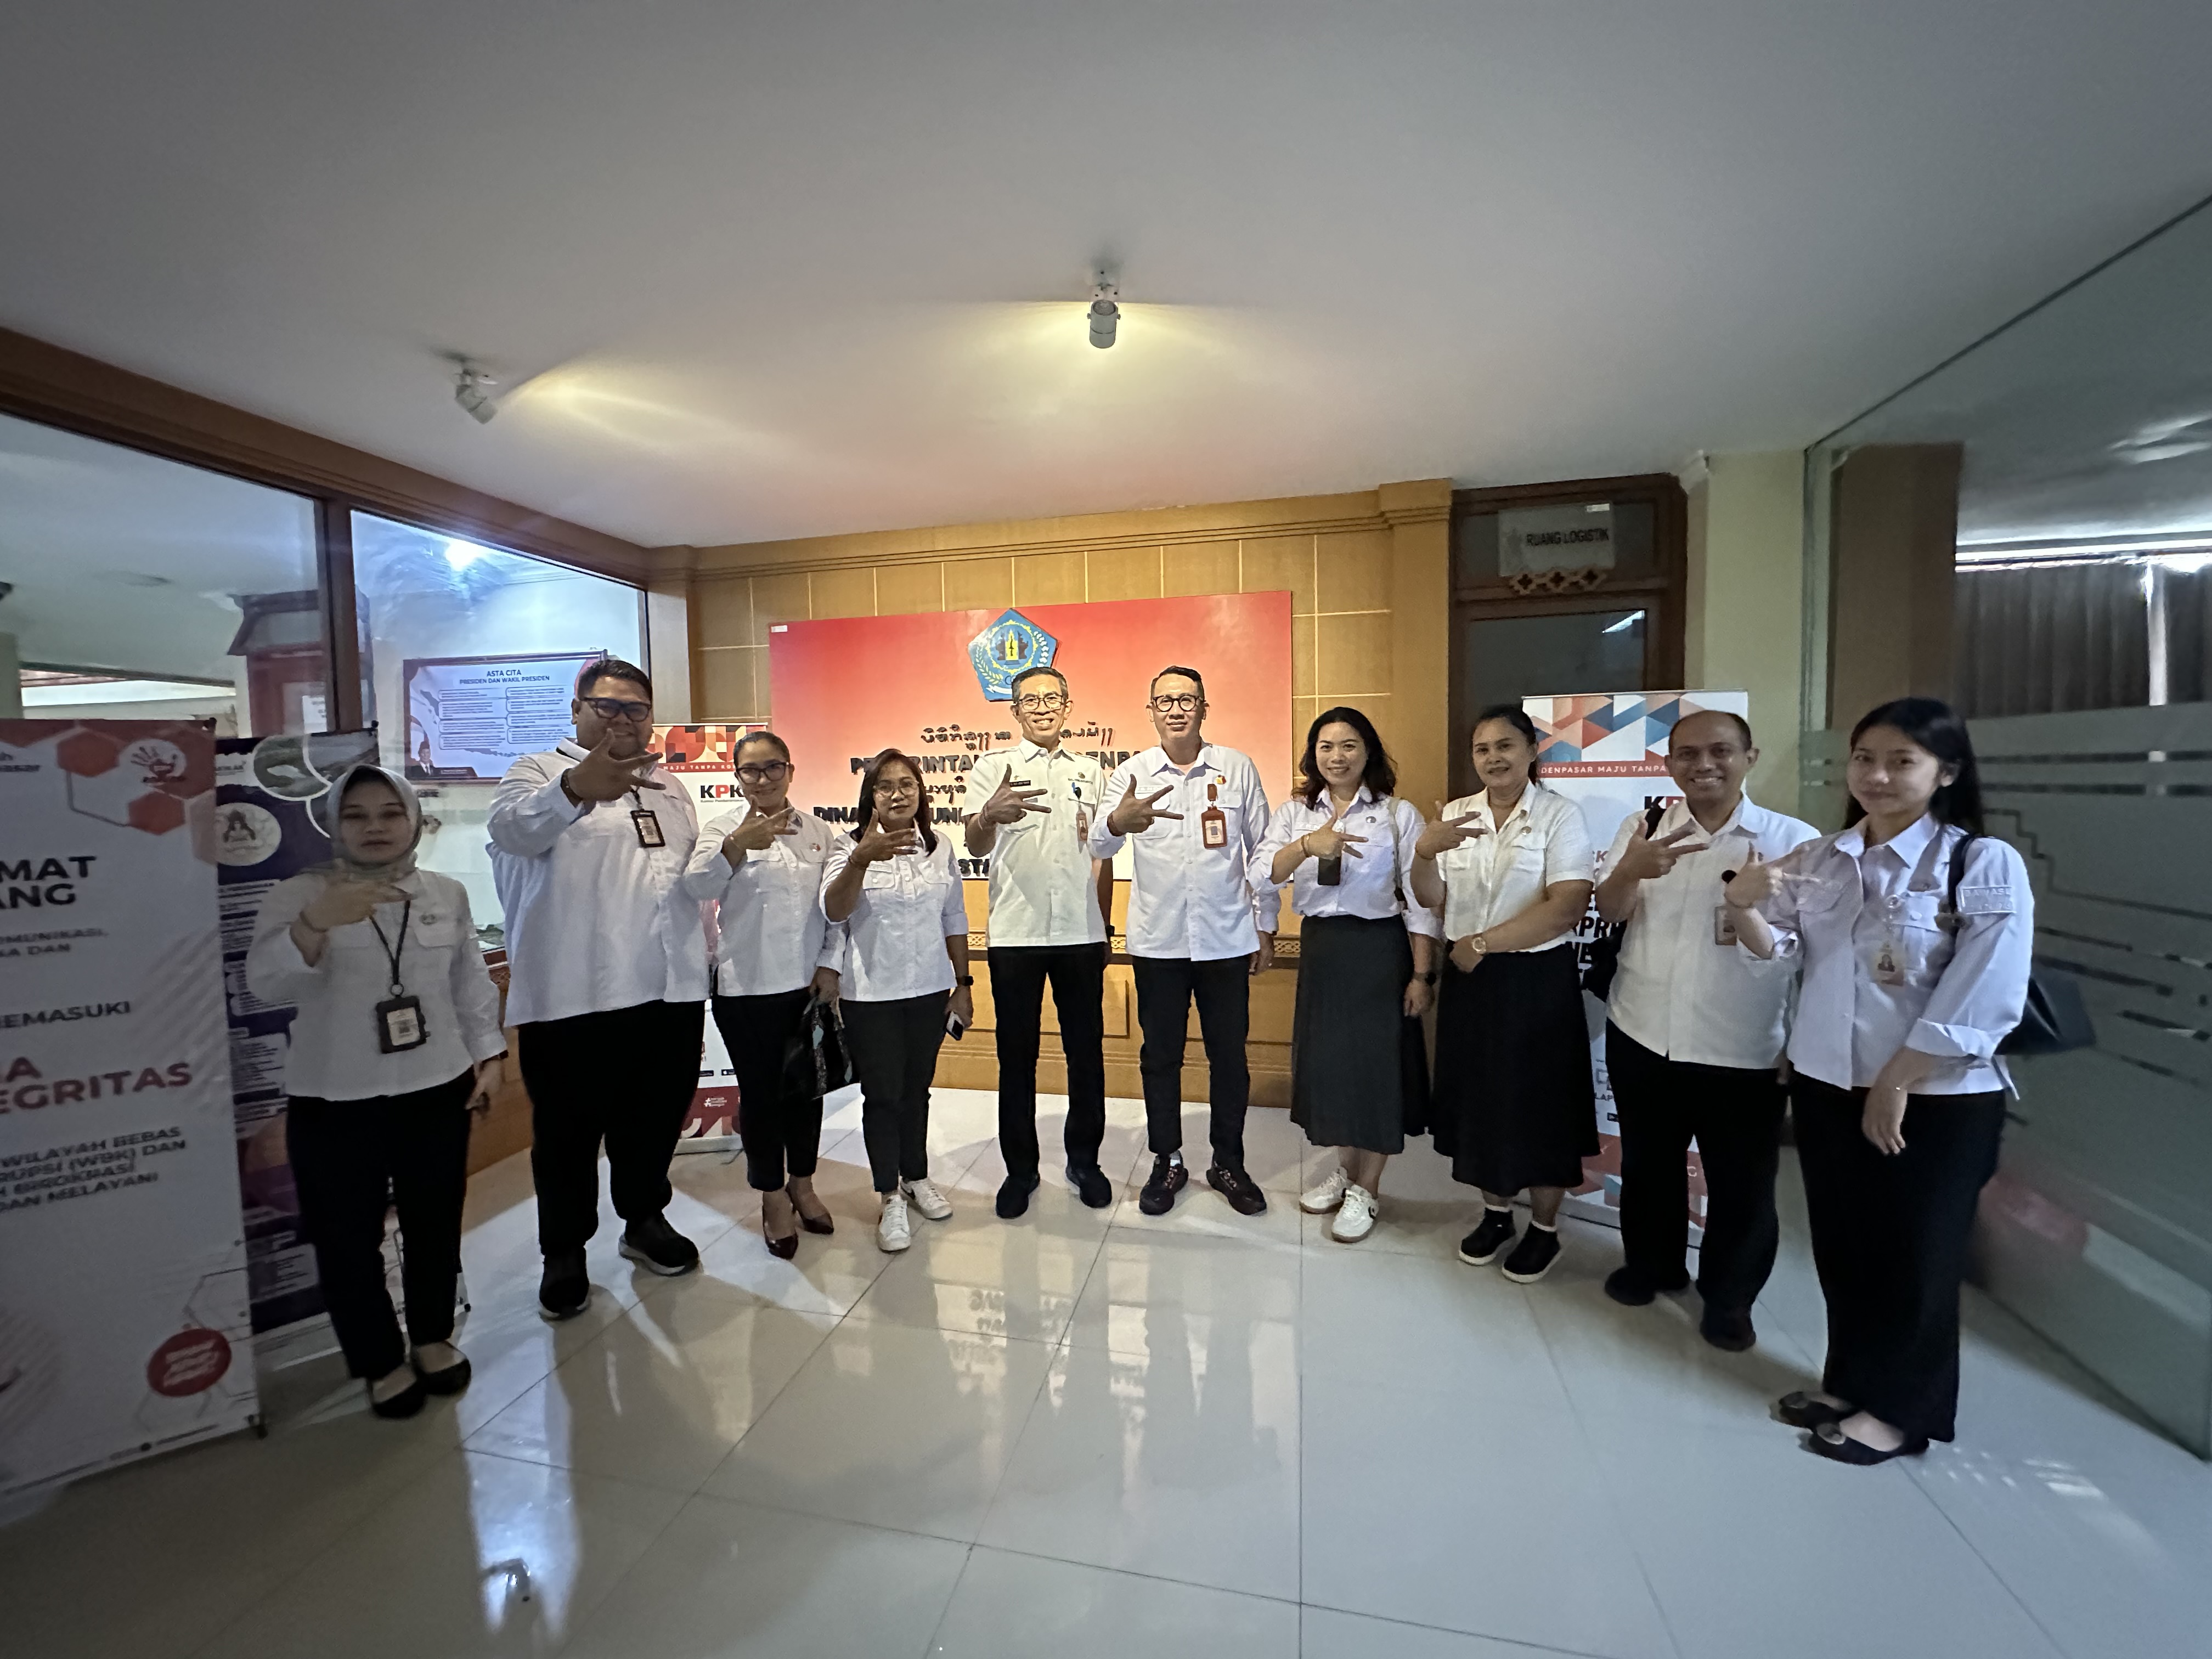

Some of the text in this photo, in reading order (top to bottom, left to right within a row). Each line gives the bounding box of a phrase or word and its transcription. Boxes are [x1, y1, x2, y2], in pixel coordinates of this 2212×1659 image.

[1541, 766, 1593, 774] DENPASAR
[701, 785, 744, 799] KPK
[27, 944, 70, 955] DAN
[0, 1001, 131, 1028] EMASUKI
[113, 1127, 180, 1148] BEBAS
[142, 1139, 185, 1156] DAN
